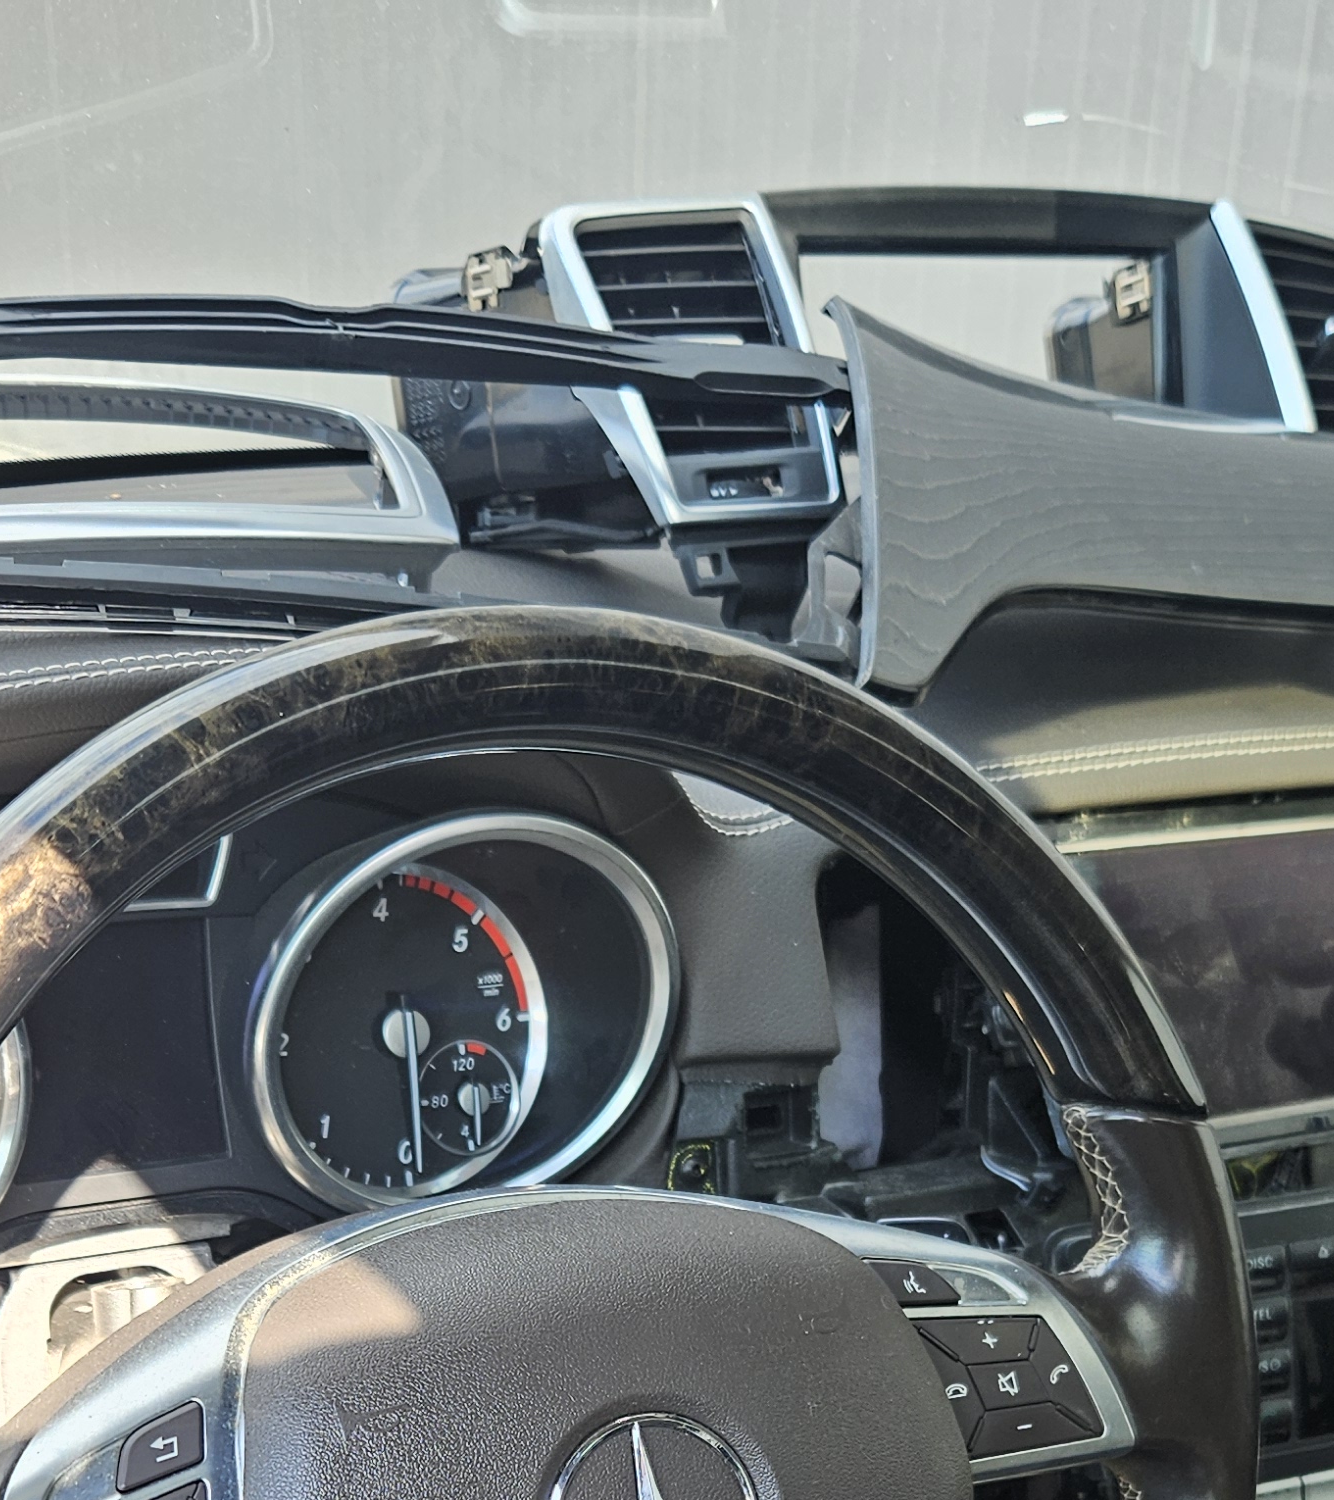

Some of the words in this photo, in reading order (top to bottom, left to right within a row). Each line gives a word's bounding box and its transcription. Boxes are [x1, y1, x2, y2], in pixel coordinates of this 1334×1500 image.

[372, 897, 390, 923] 4
[451, 927, 469, 953] 5
[495, 1005, 512, 1032] 6
[451, 1056, 476, 1072] 120
[430, 1094, 449, 1109] 80
[319, 1113, 331, 1139] 1
